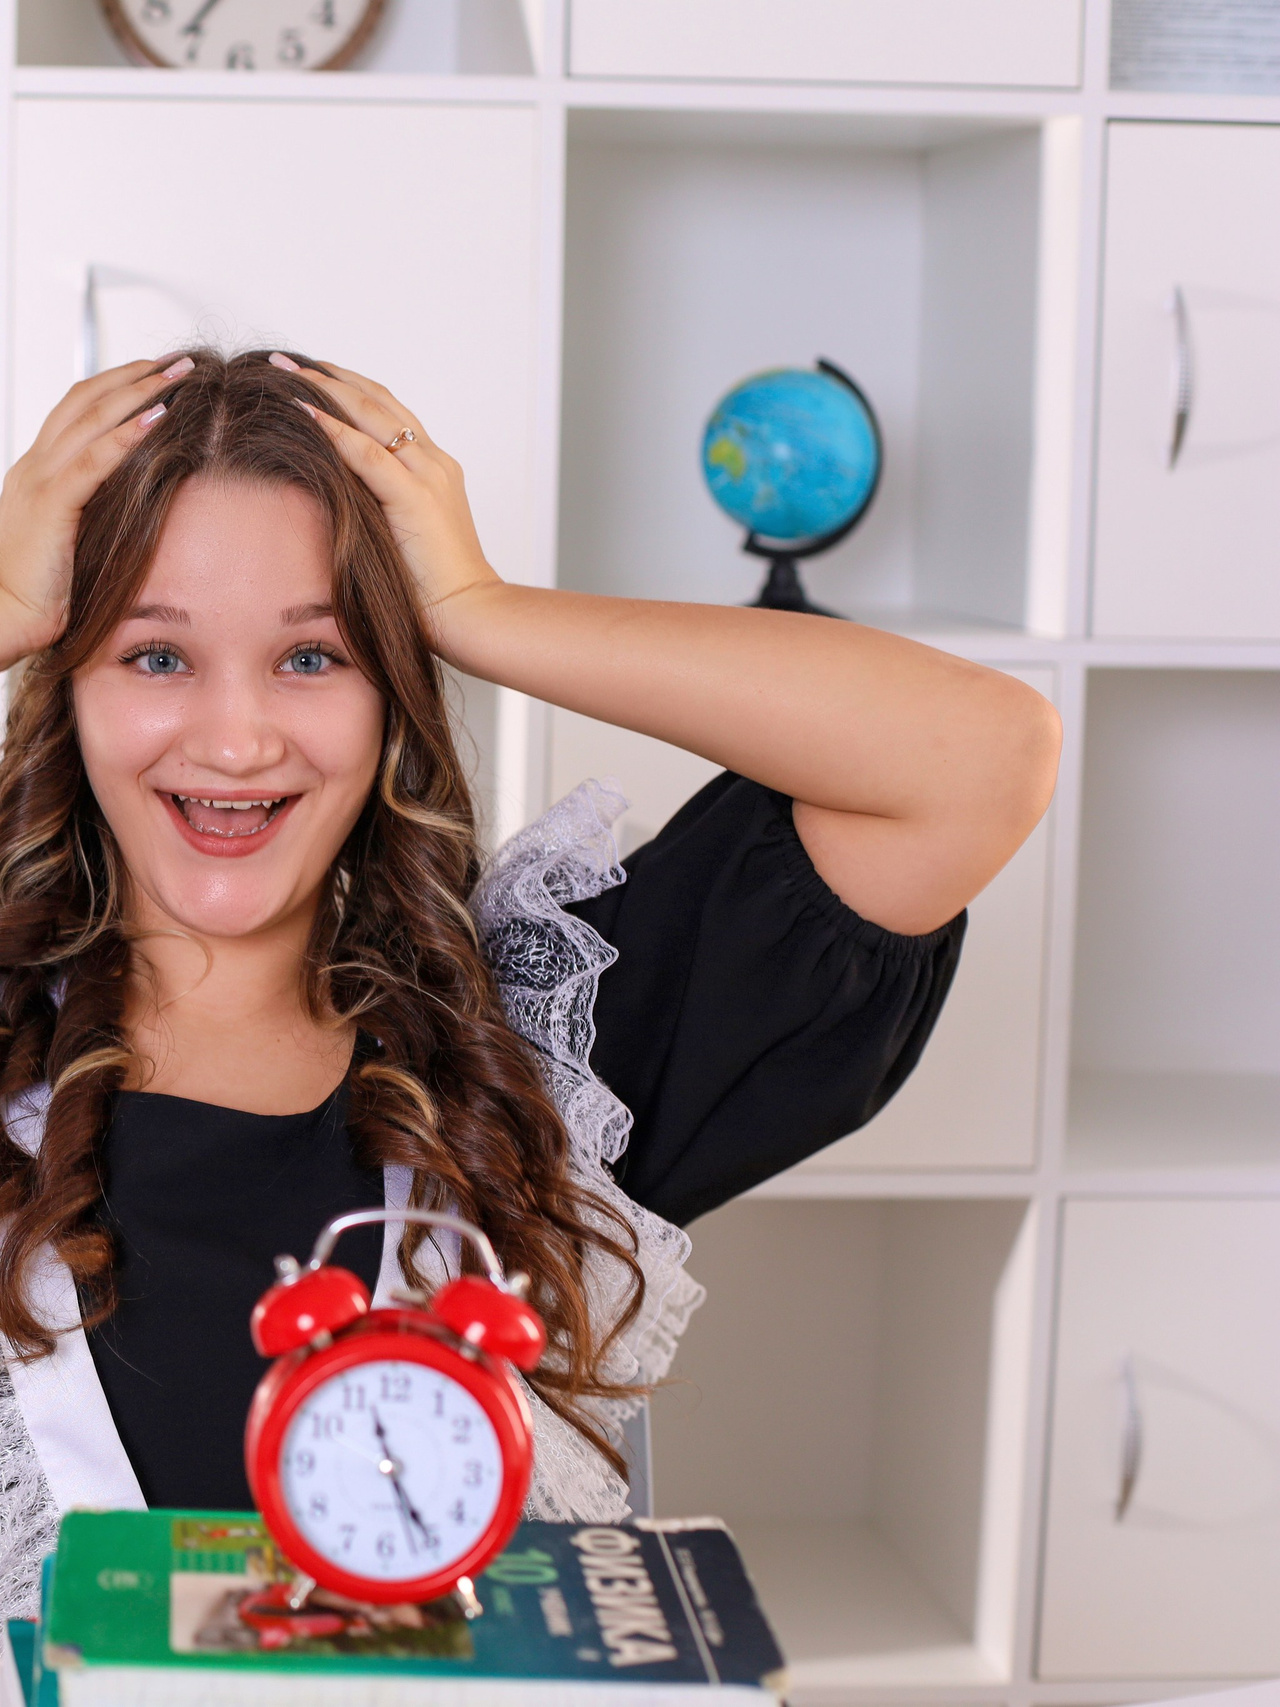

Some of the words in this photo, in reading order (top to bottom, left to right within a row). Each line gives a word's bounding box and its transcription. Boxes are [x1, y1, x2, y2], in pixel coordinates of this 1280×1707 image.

[278, 27, 305, 63] 5
[342, 1383, 366, 1411] 11
[379, 1372, 411, 1402] 12
[433, 1389, 444, 1417] 1
[311, 1412, 343, 1438] 10
[452, 1416, 471, 1444] 2
[296, 1450, 314, 1476] 9
[464, 1461, 483, 1487] 3
[310, 1493, 327, 1519] 8
[448, 1498, 466, 1524] 4
[339, 1523, 357, 1551] 7
[376, 1531, 395, 1558] 6
[423, 1523, 441, 1551] 5
[486, 1549, 558, 1584] 10
[570, 1527, 677, 1667] ФИЗИКА
